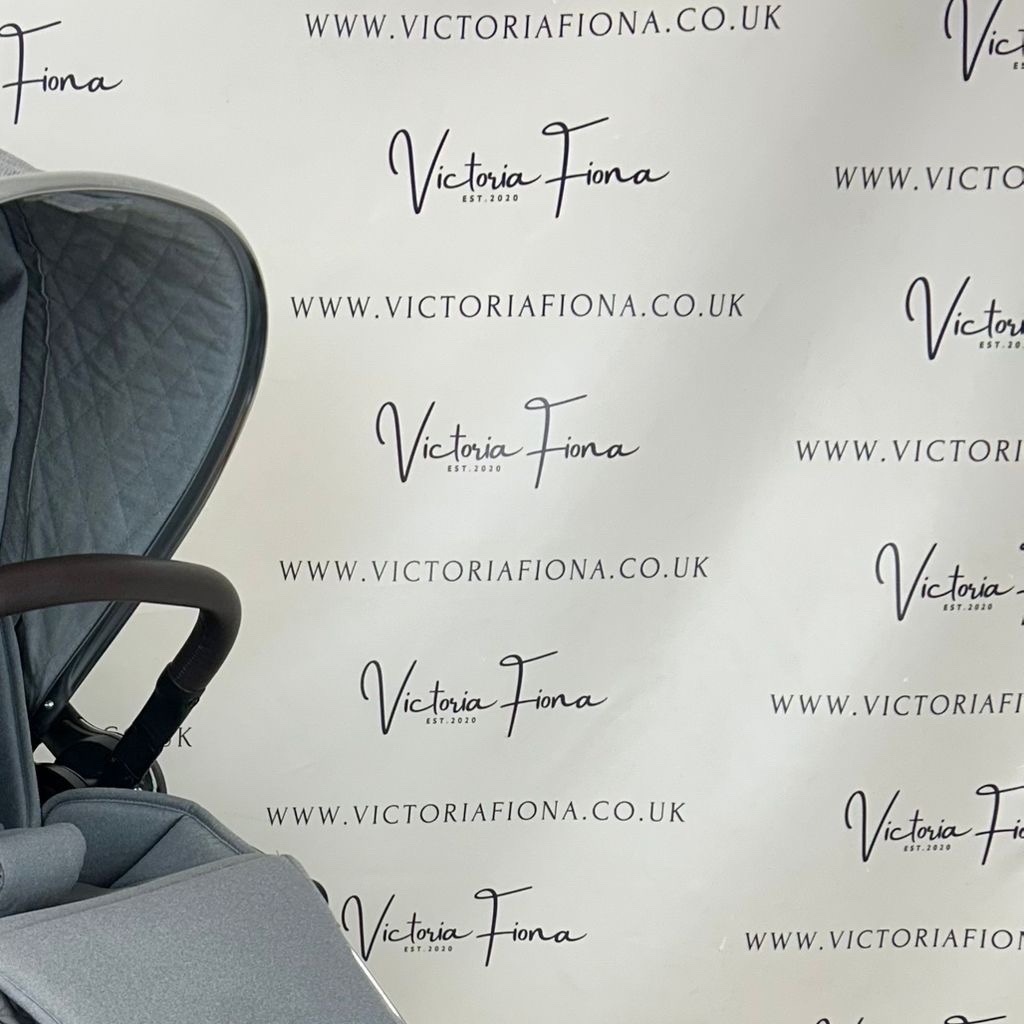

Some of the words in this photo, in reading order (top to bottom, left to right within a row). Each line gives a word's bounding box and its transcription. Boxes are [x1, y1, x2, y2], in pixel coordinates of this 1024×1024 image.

[305, 5, 782, 40] WWW.VICTORIAFIONA.CO.UK
[388, 129, 542, 215] Victoria
[542, 117, 670, 219] Fiona
[290, 294, 745, 320] WWW.VICTORIAFIONA.CO.UK
[376, 401, 523, 483] Victoria
[524, 394, 640, 489] Fiona
[280, 556, 709, 582] WWW.VICTORIAFIONA.CO.UK
[875, 542, 1015, 621] Victoria
[360, 660, 498, 735] Victoria
[499, 651, 608, 738] Fiona
[266, 801, 685, 827] WWW.VICTORIAFIONA.CO.UK
[844, 790, 973, 862] Victoria
[342, 894, 473, 962] Victoria
[474, 886, 587, 967] Fiona
